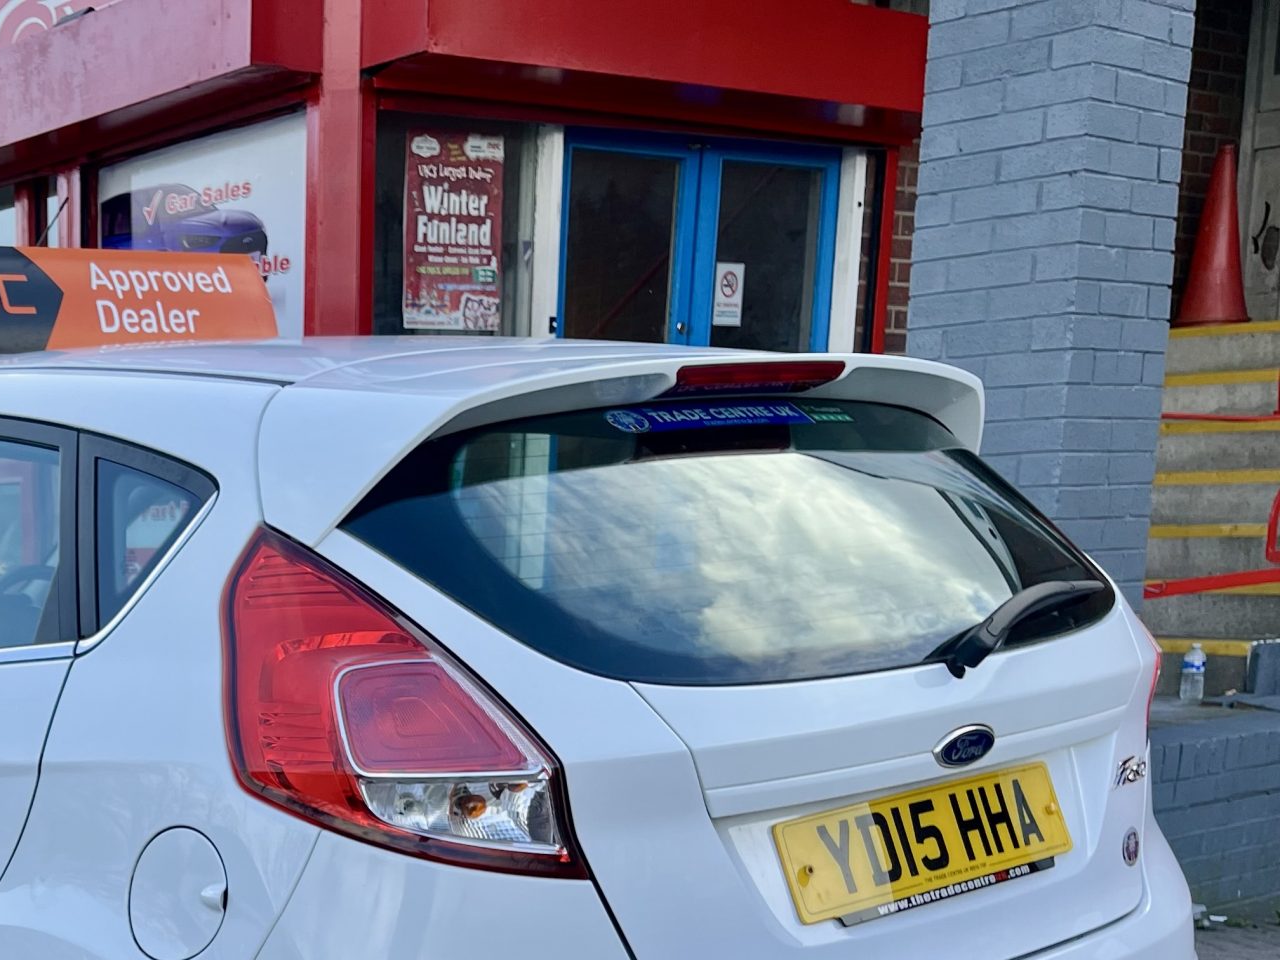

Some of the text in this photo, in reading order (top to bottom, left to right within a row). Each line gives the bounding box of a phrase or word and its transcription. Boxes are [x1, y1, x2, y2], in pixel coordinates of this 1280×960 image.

[165, 181, 253, 215] Car Sales
[422, 181, 489, 217] Winter
[416, 214, 492, 247] Funland
[89, 262, 232, 299] Approved
[98, 300, 201, 334] Dealer
[648, 407, 712, 424] TRADE
[709, 406, 773, 419] CENTRE
[770, 405, 800, 417] UK
[815, 779, 1045, 895] YD15 HHA
